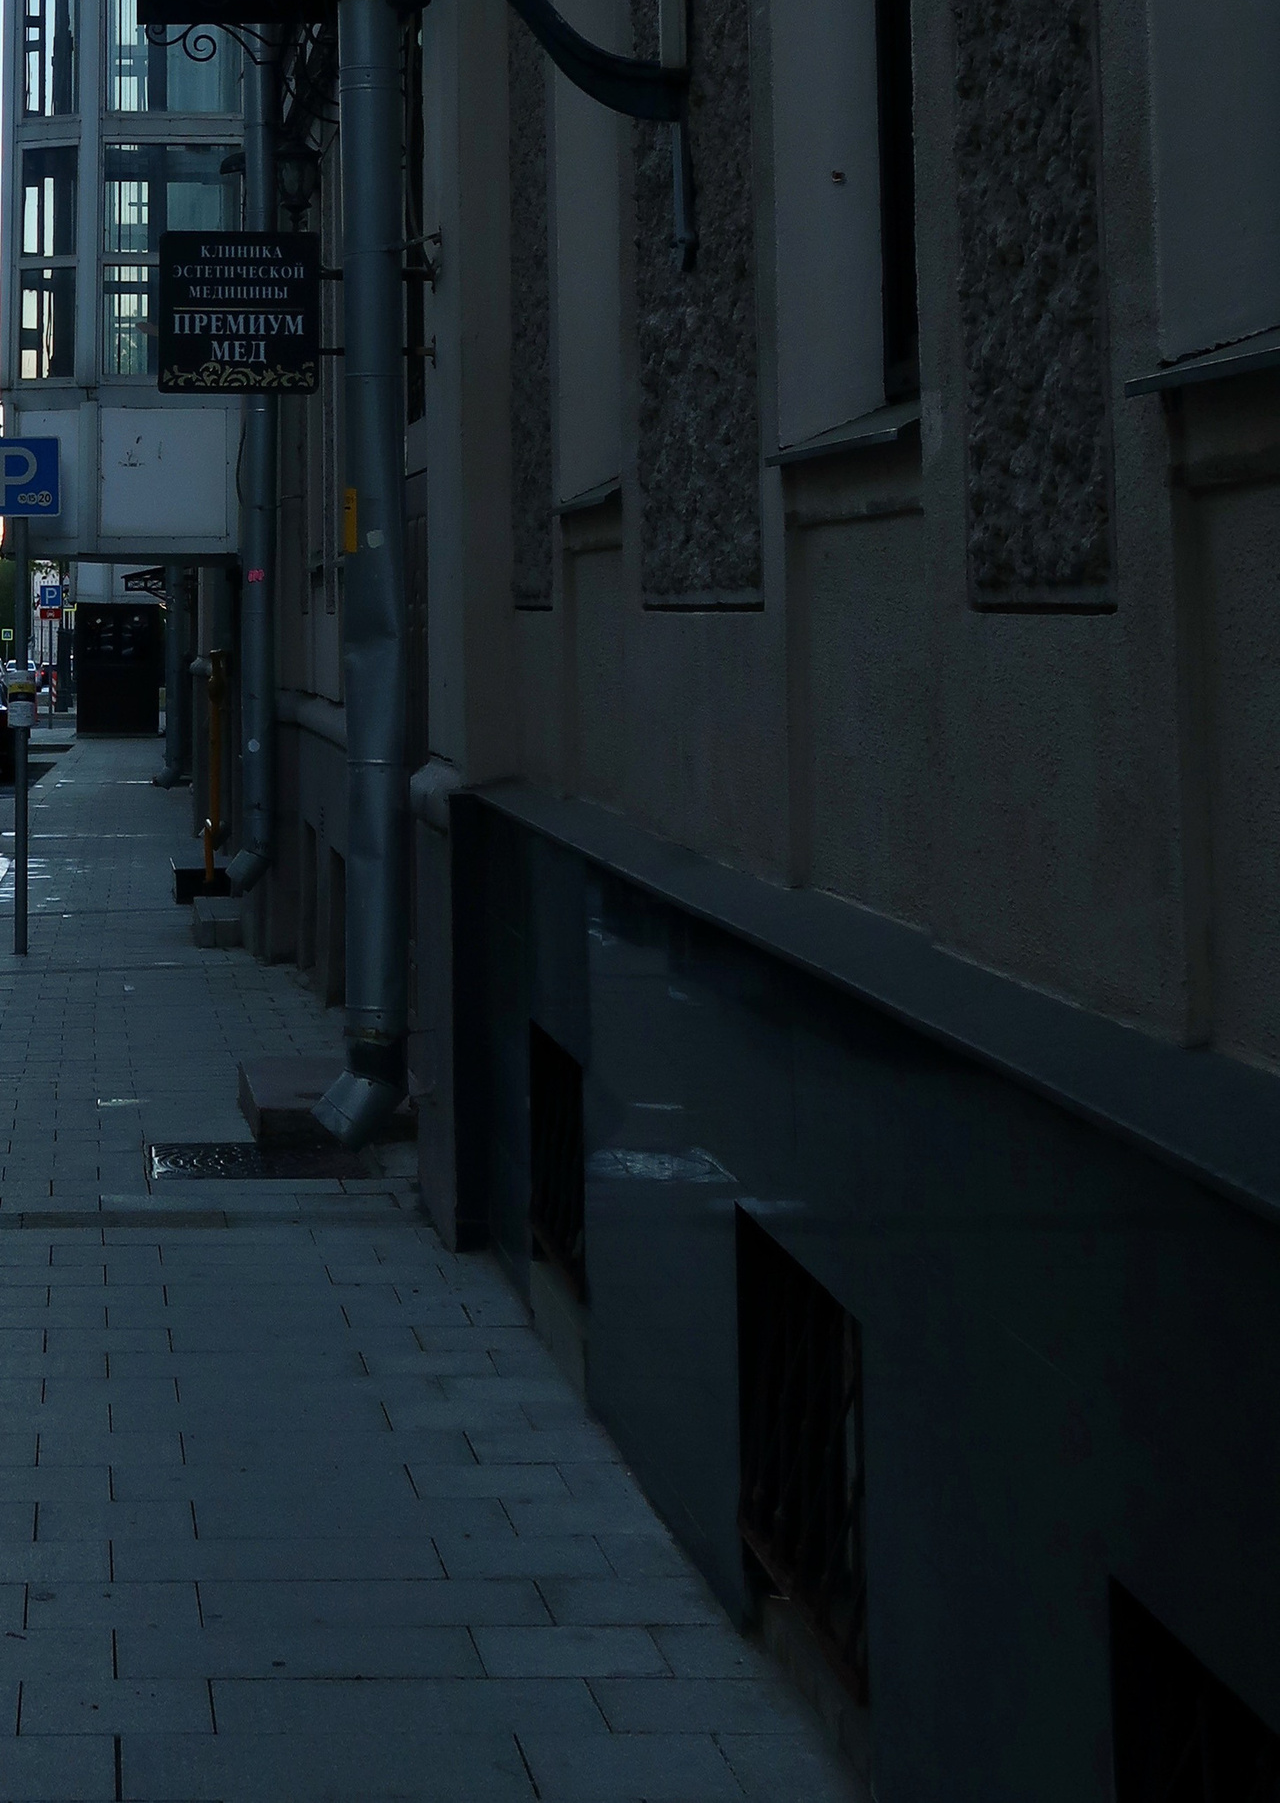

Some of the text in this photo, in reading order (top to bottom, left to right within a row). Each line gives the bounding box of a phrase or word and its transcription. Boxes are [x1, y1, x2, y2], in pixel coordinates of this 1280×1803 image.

[200, 245, 283, 258] КЛИНИКА
[172, 262, 305, 279] ЭСТЕТИЧЕСКОЙ
[188, 285, 289, 300] МЕДИЦИНЫ
[173, 313, 304, 335] ПРЕМИУМ
[210, 340, 267, 364] МЕД
[38, 493, 51, 503] 20
[45, 588, 57, 604] P
